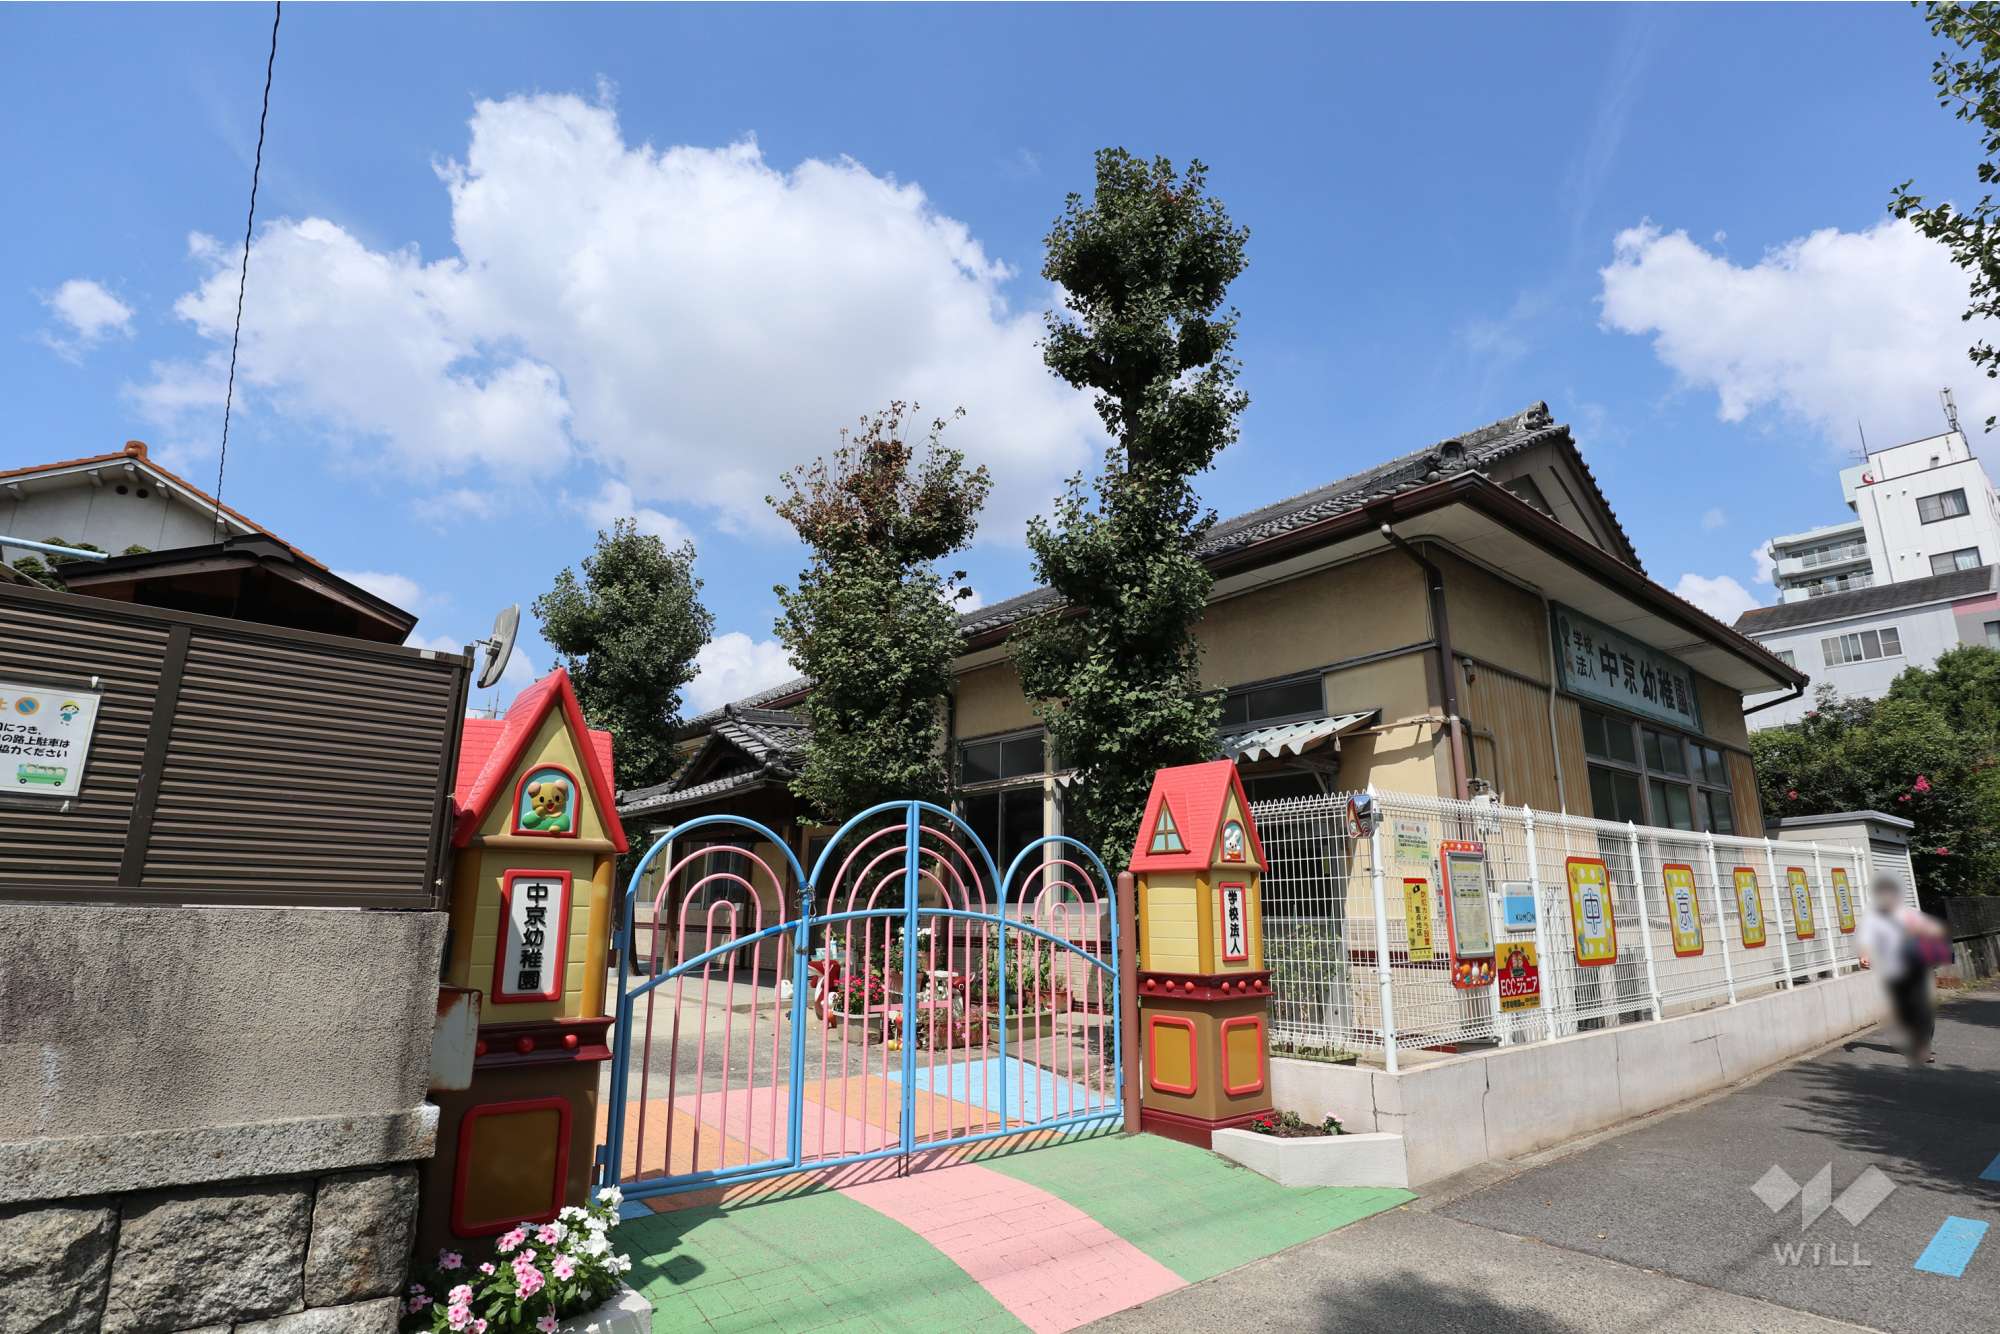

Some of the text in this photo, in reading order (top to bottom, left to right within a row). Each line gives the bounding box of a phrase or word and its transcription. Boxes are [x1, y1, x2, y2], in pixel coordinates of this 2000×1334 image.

[1573, 629, 1594, 656] 学校
[1576, 655, 1596, 681] 法人
[1599, 643, 1690, 717] 中京幼稚園
[0, 722, 41, 736] につき、
[1228, 889, 1241, 955] 学校法人
[518, 883, 548, 990] 中京幼稚園
[1501, 976, 1538, 996] ECCジュニア
